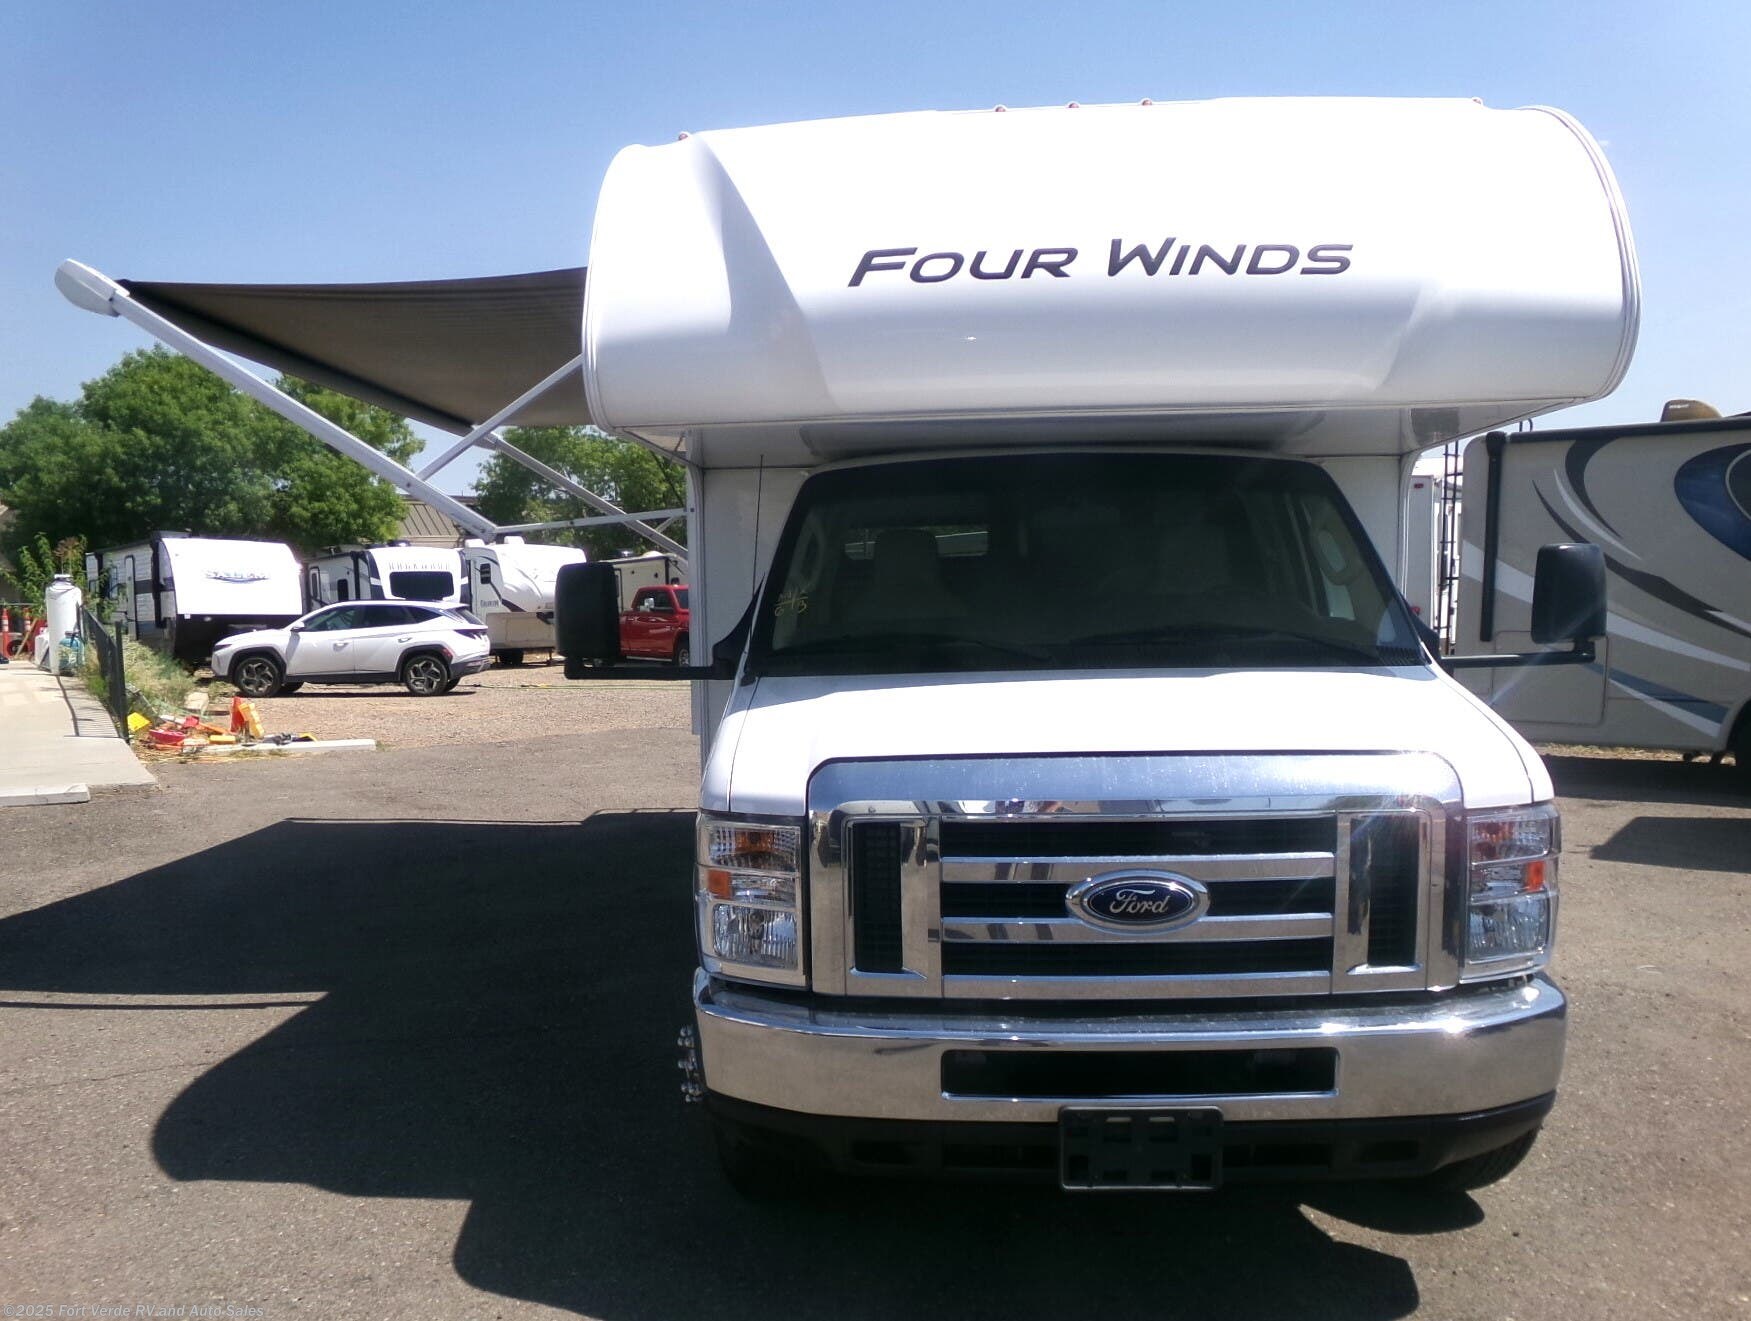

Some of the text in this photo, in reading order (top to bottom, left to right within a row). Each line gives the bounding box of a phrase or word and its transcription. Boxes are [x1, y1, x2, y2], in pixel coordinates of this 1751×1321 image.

[847, 237, 1353, 287] FOUR WINDS
[1109, 889, 1170, 913] Ford
